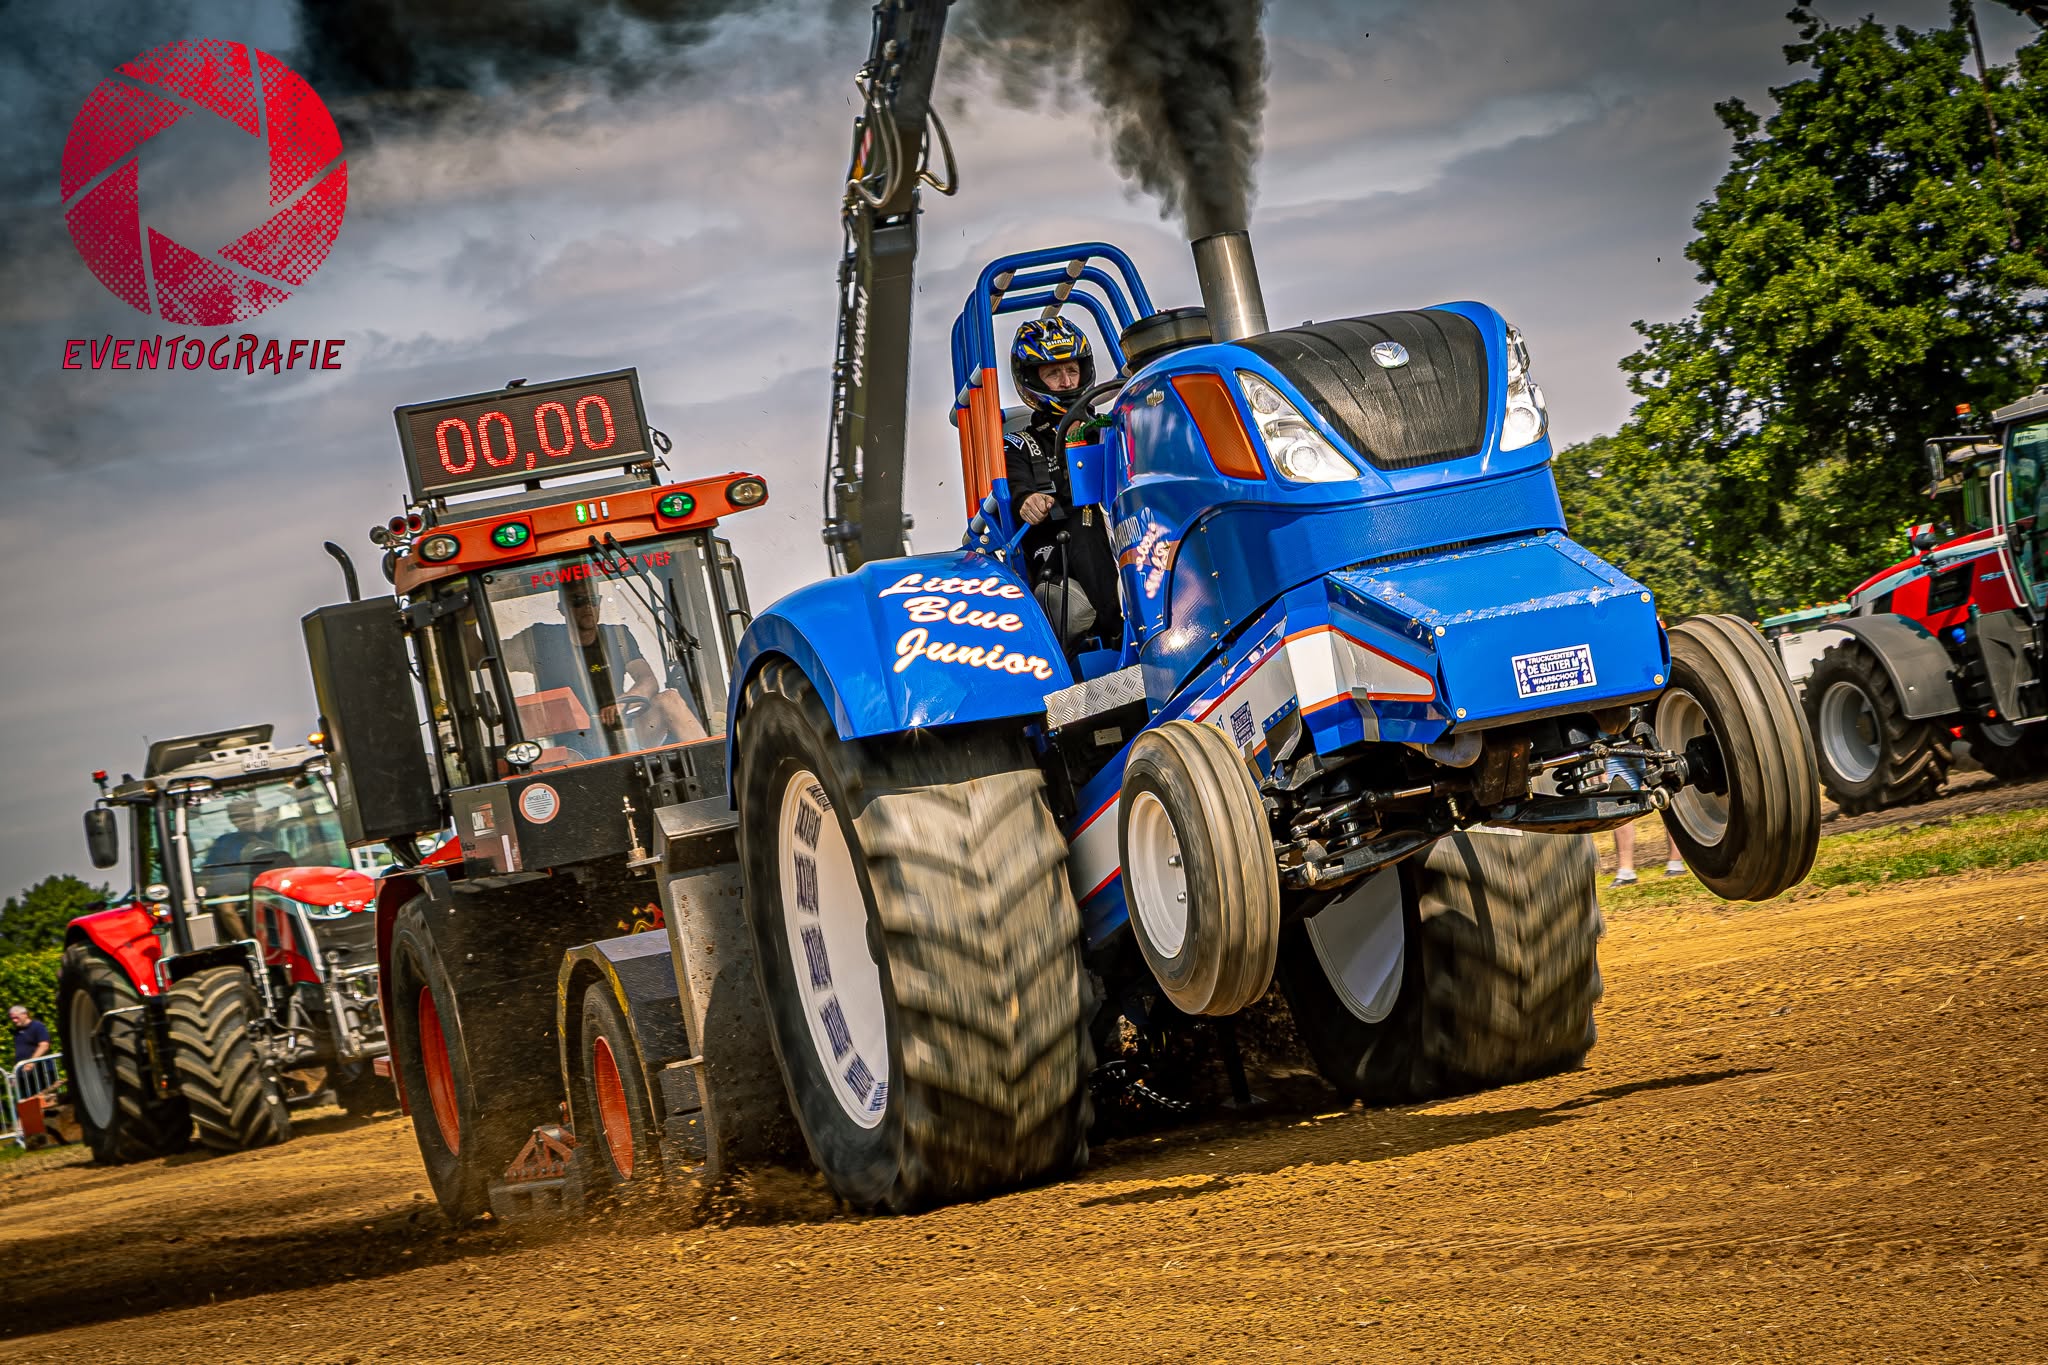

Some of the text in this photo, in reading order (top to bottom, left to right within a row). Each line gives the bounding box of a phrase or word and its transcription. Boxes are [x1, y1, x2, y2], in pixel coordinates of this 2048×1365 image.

[1046, 338, 1072, 346] SHARK
[435, 395, 617, 474] 00,00
[642, 551, 672, 568] VEF
[878, 573, 1024, 599] Little
[902, 595, 1024, 632] Blue
[893, 627, 1053, 680] Junior
[1527, 651, 1575, 664] TRUCKCENTER
[1539, 659, 1570, 673] SUTTER
[1532, 671, 1579, 685] WAARSCHOOT
